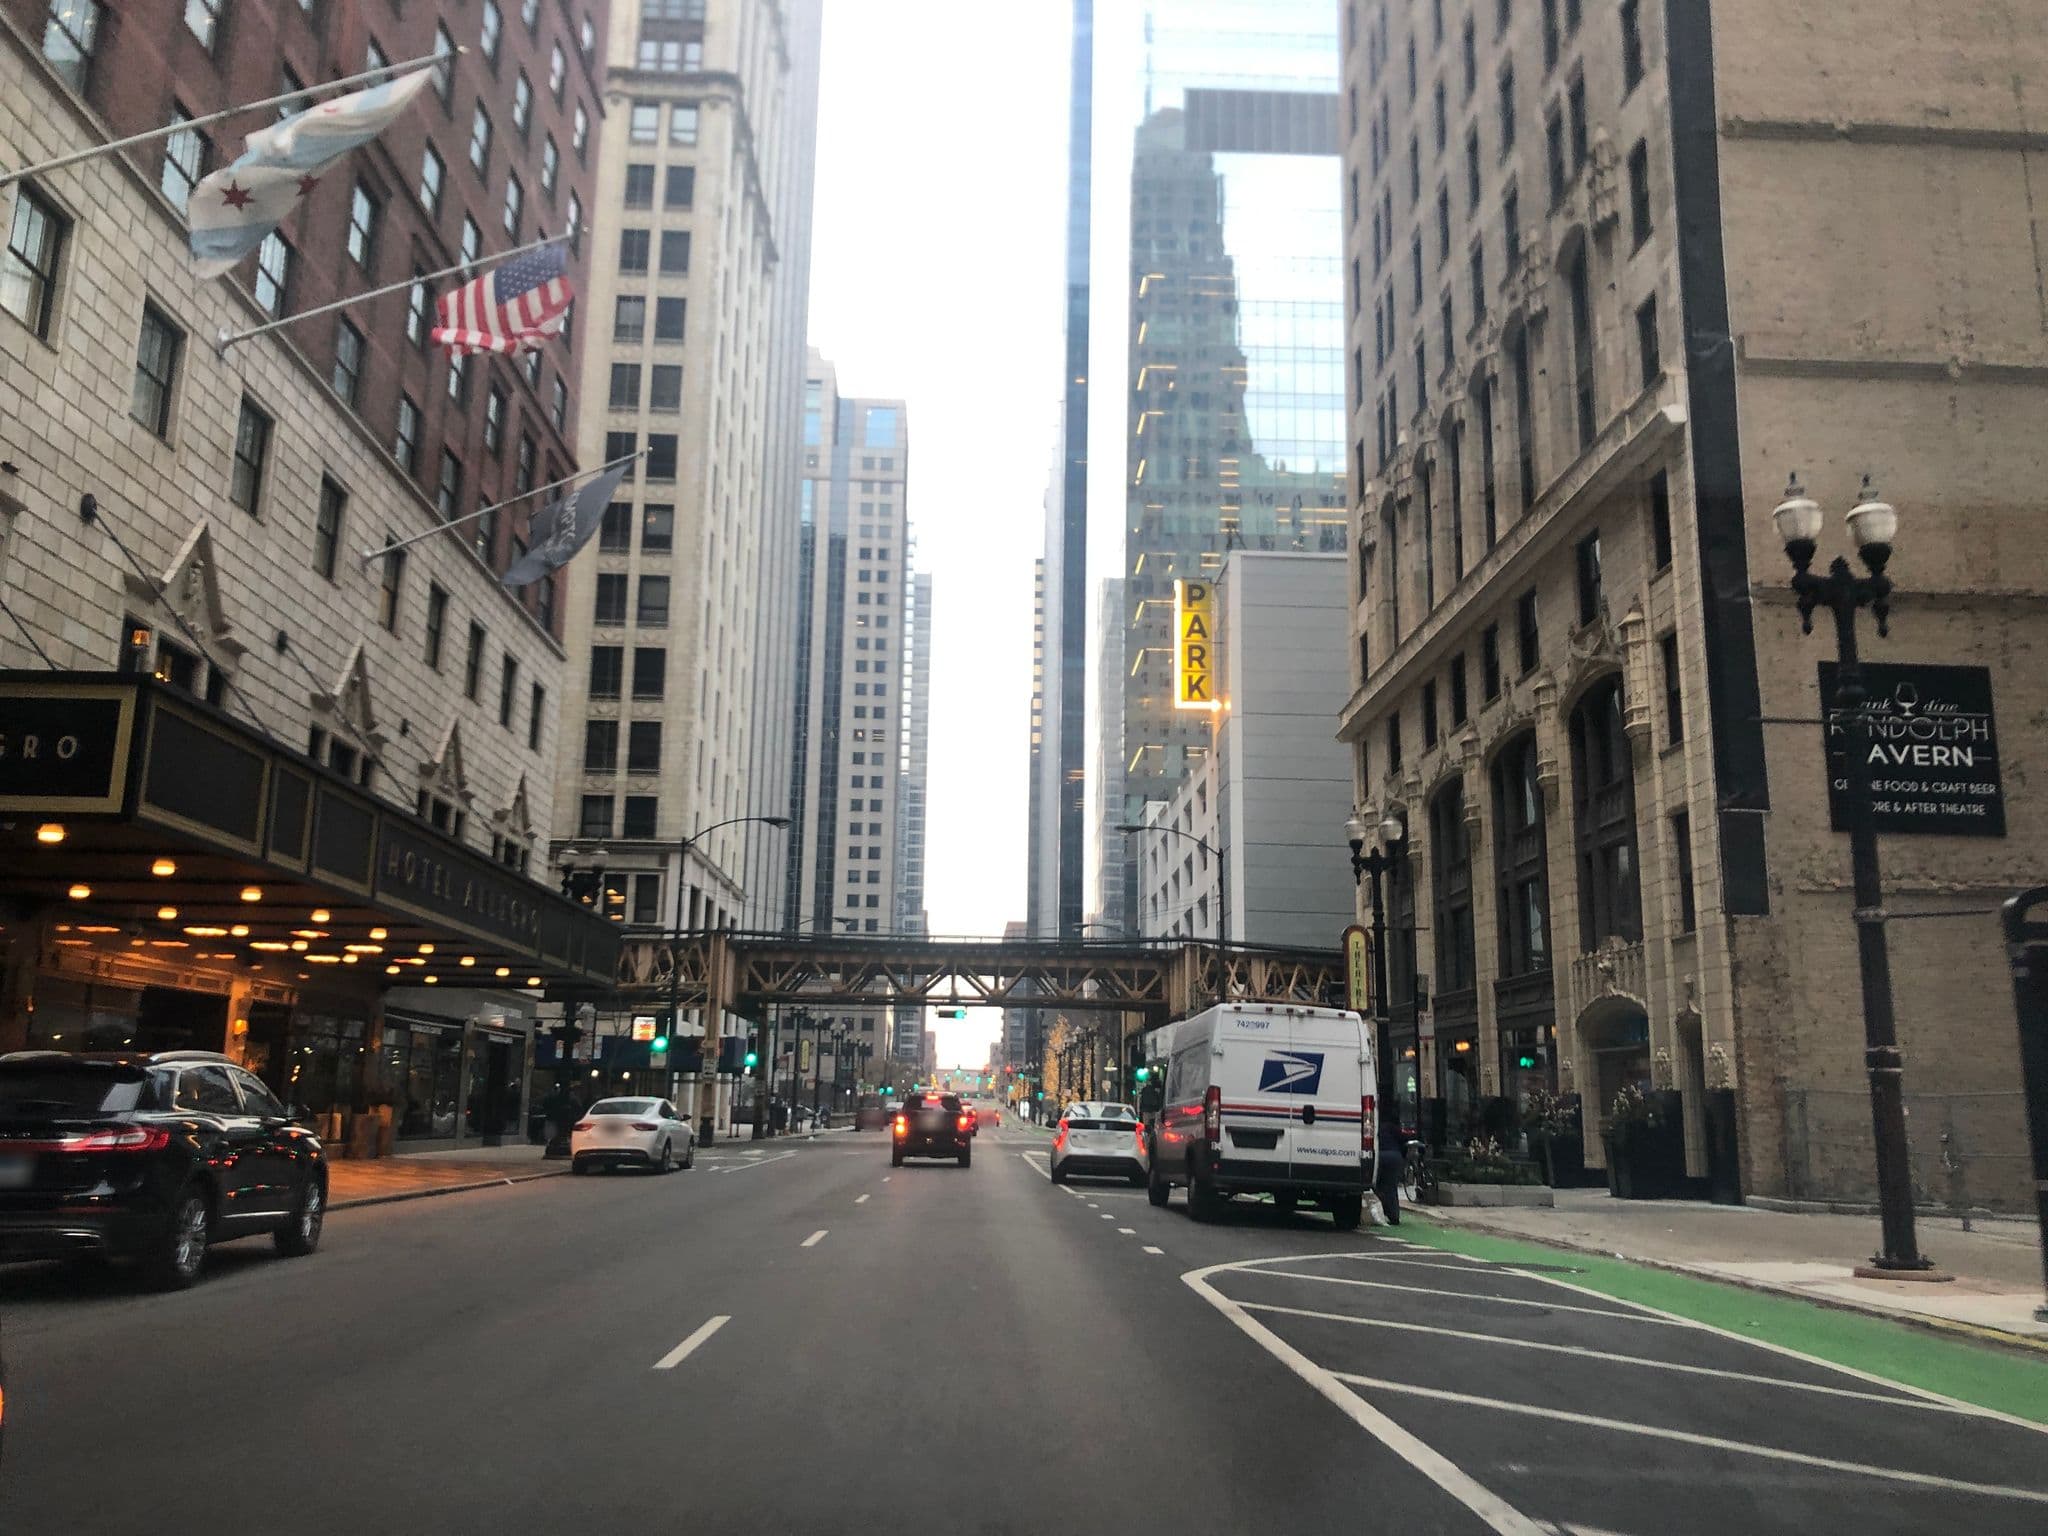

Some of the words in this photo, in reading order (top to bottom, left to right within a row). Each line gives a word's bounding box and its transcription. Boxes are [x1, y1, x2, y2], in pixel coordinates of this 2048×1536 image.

[1186, 583, 1207, 699] PARK
[1829, 713, 1989, 741] RNDOLPH
[1884, 780, 1919, 793] FOOD
[1921, 781, 1929, 793] &
[1931, 782, 1967, 794] CRAFT
[1969, 784, 1996, 795] BEER
[1893, 802, 1901, 813] &
[1904, 803, 1938, 814] AFTER
[1940, 804, 1986, 816] THEATRE
[1296, 1147, 1356, 1157] www.usps.com
